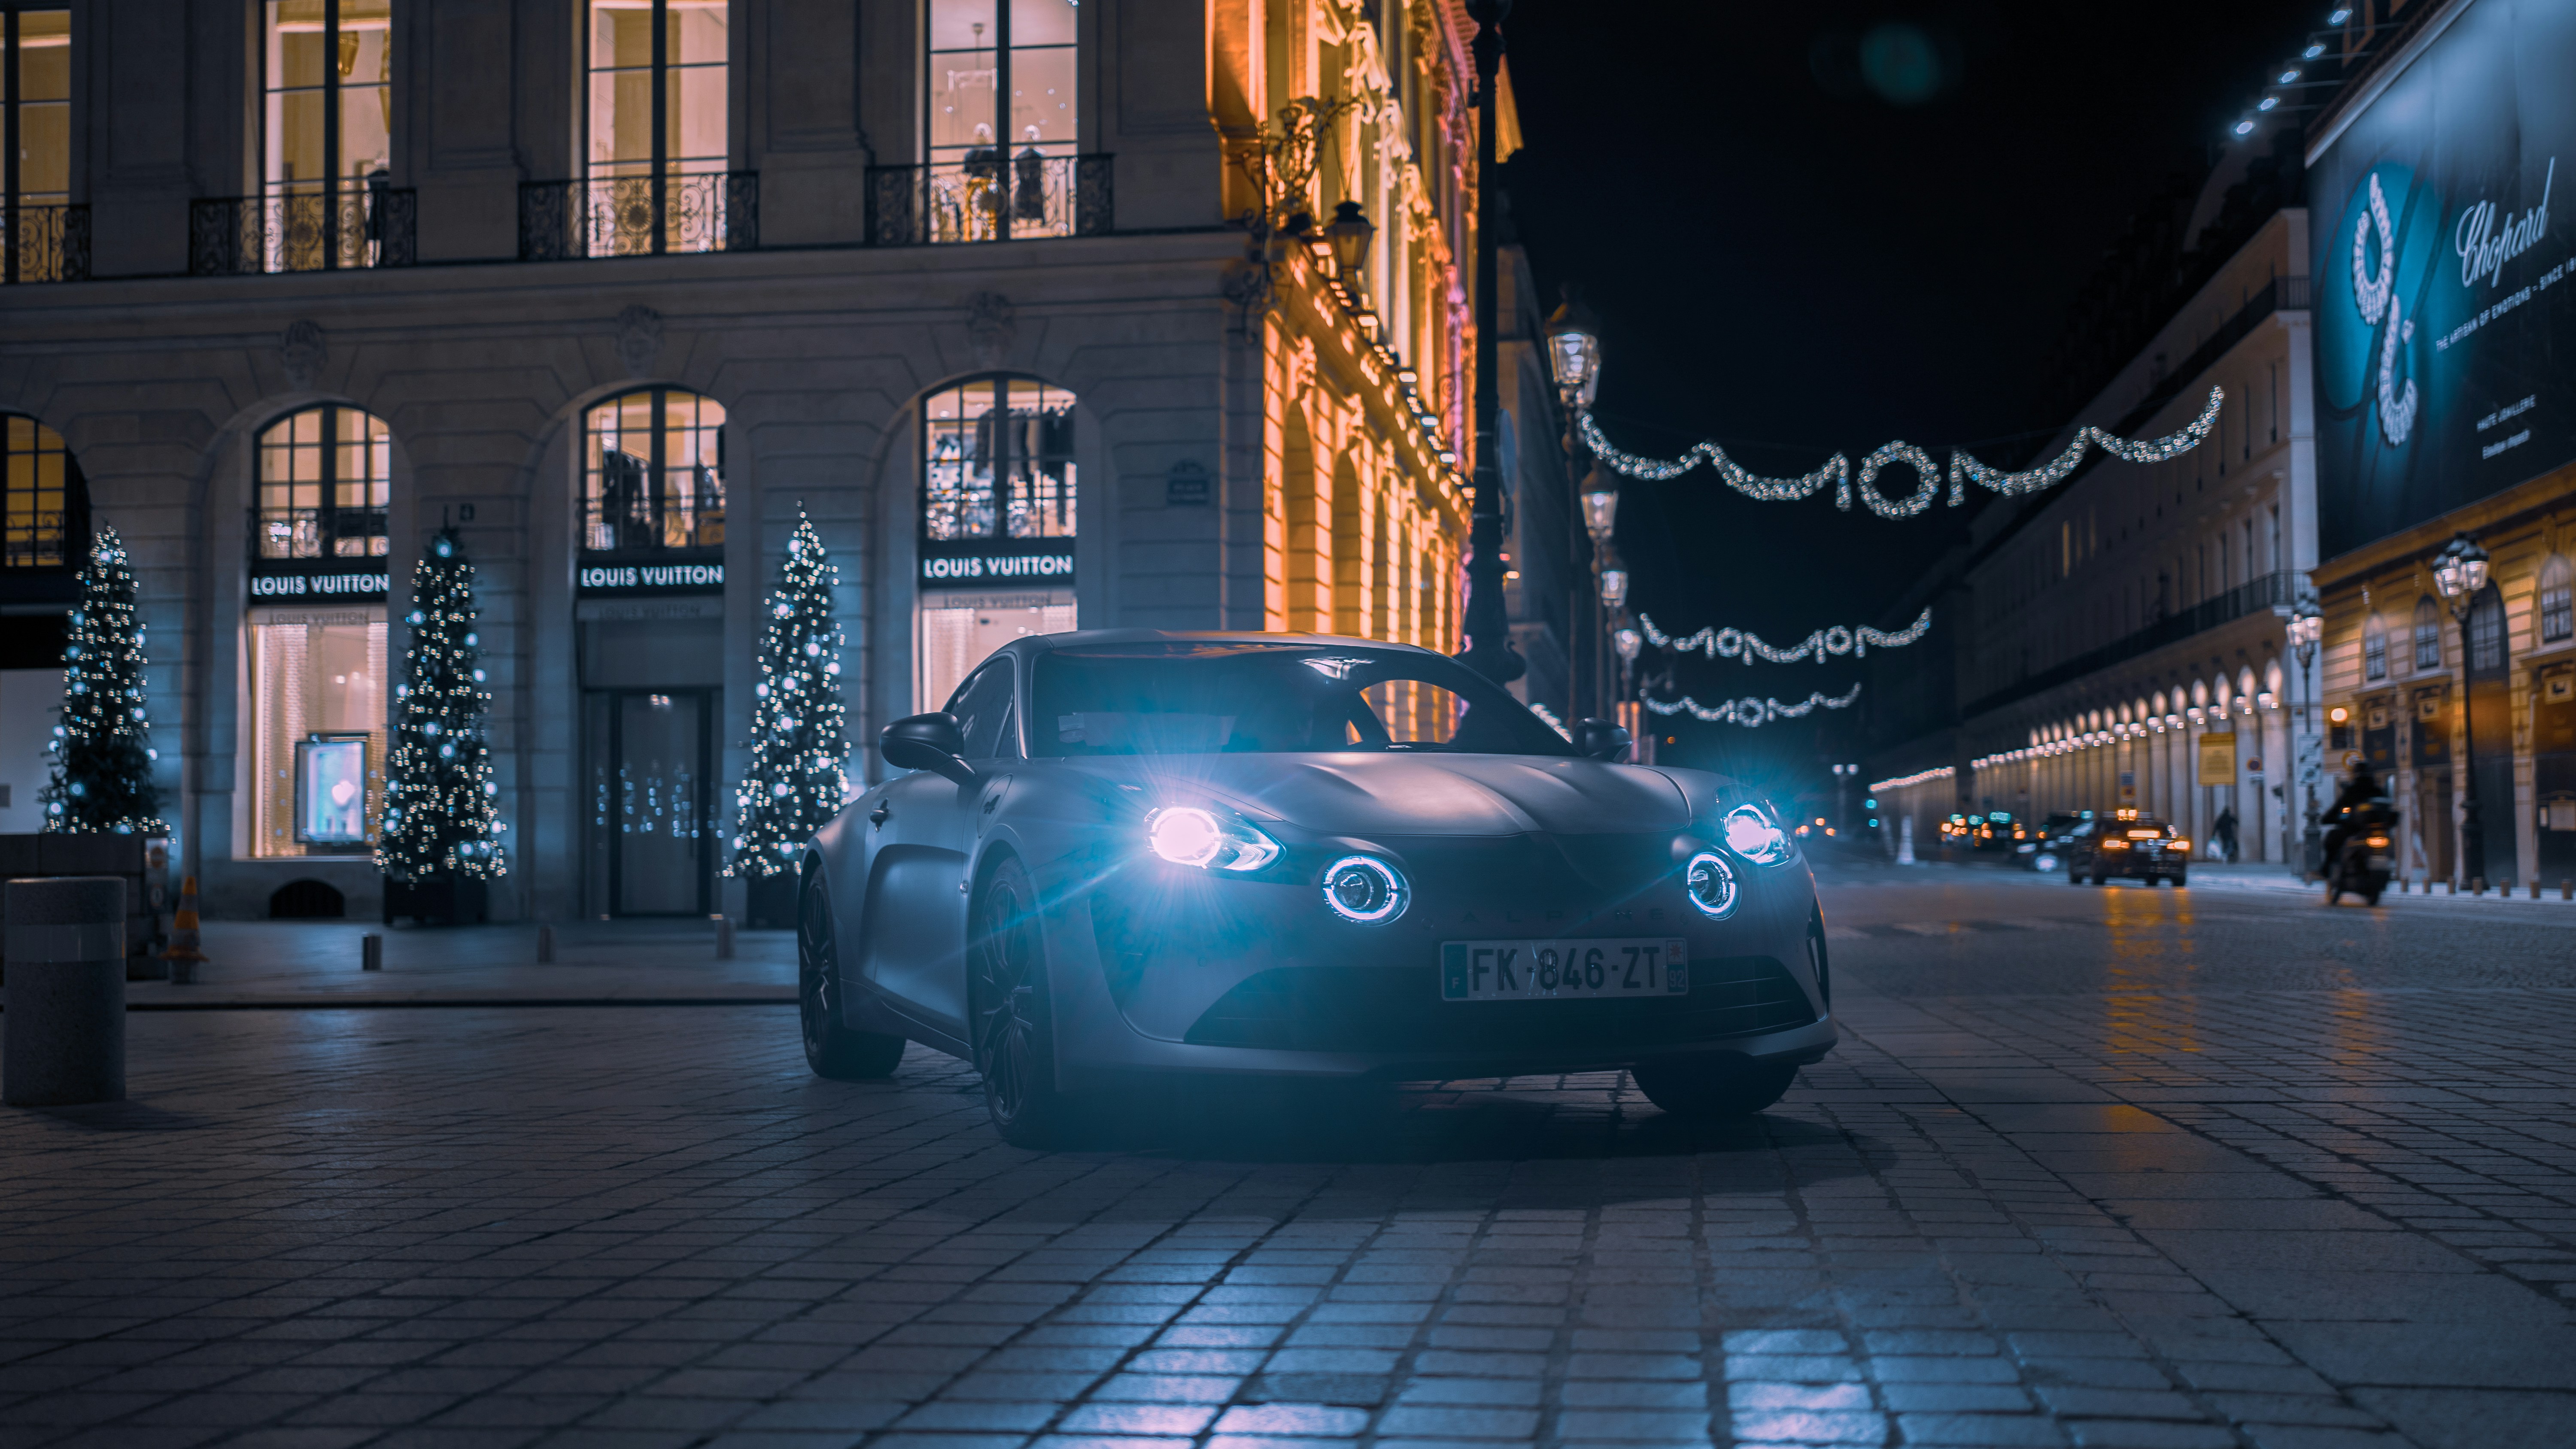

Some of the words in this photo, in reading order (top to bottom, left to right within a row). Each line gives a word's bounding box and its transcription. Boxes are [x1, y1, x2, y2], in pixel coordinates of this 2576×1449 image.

[2455, 156, 2555, 288] Chopard
[2436, 335, 2449, 352] THE
[2450, 317, 2478, 345] ARTISAN
[2479, 309, 2491, 327] OF
[2491, 285, 2531, 320] EMOTIONS
[2539, 264, 2564, 291] SINCE
[2565, 257, 2576, 274] 18
[581, 567, 638, 587] LOUIS
[640, 565, 724, 585] VUITTON
[923, 557, 983, 578] LOUIS
[986, 555, 1073, 576] VUITTON
[252, 576, 307, 595] LOUIS
[310, 574, 390, 593] VUITTON
[1461, 907, 1664, 923] ALPINE
[1472, 946, 1660, 991] FK-846-ZT
[1669, 970, 1685, 988] 92
[1452, 977, 1459, 988] F
